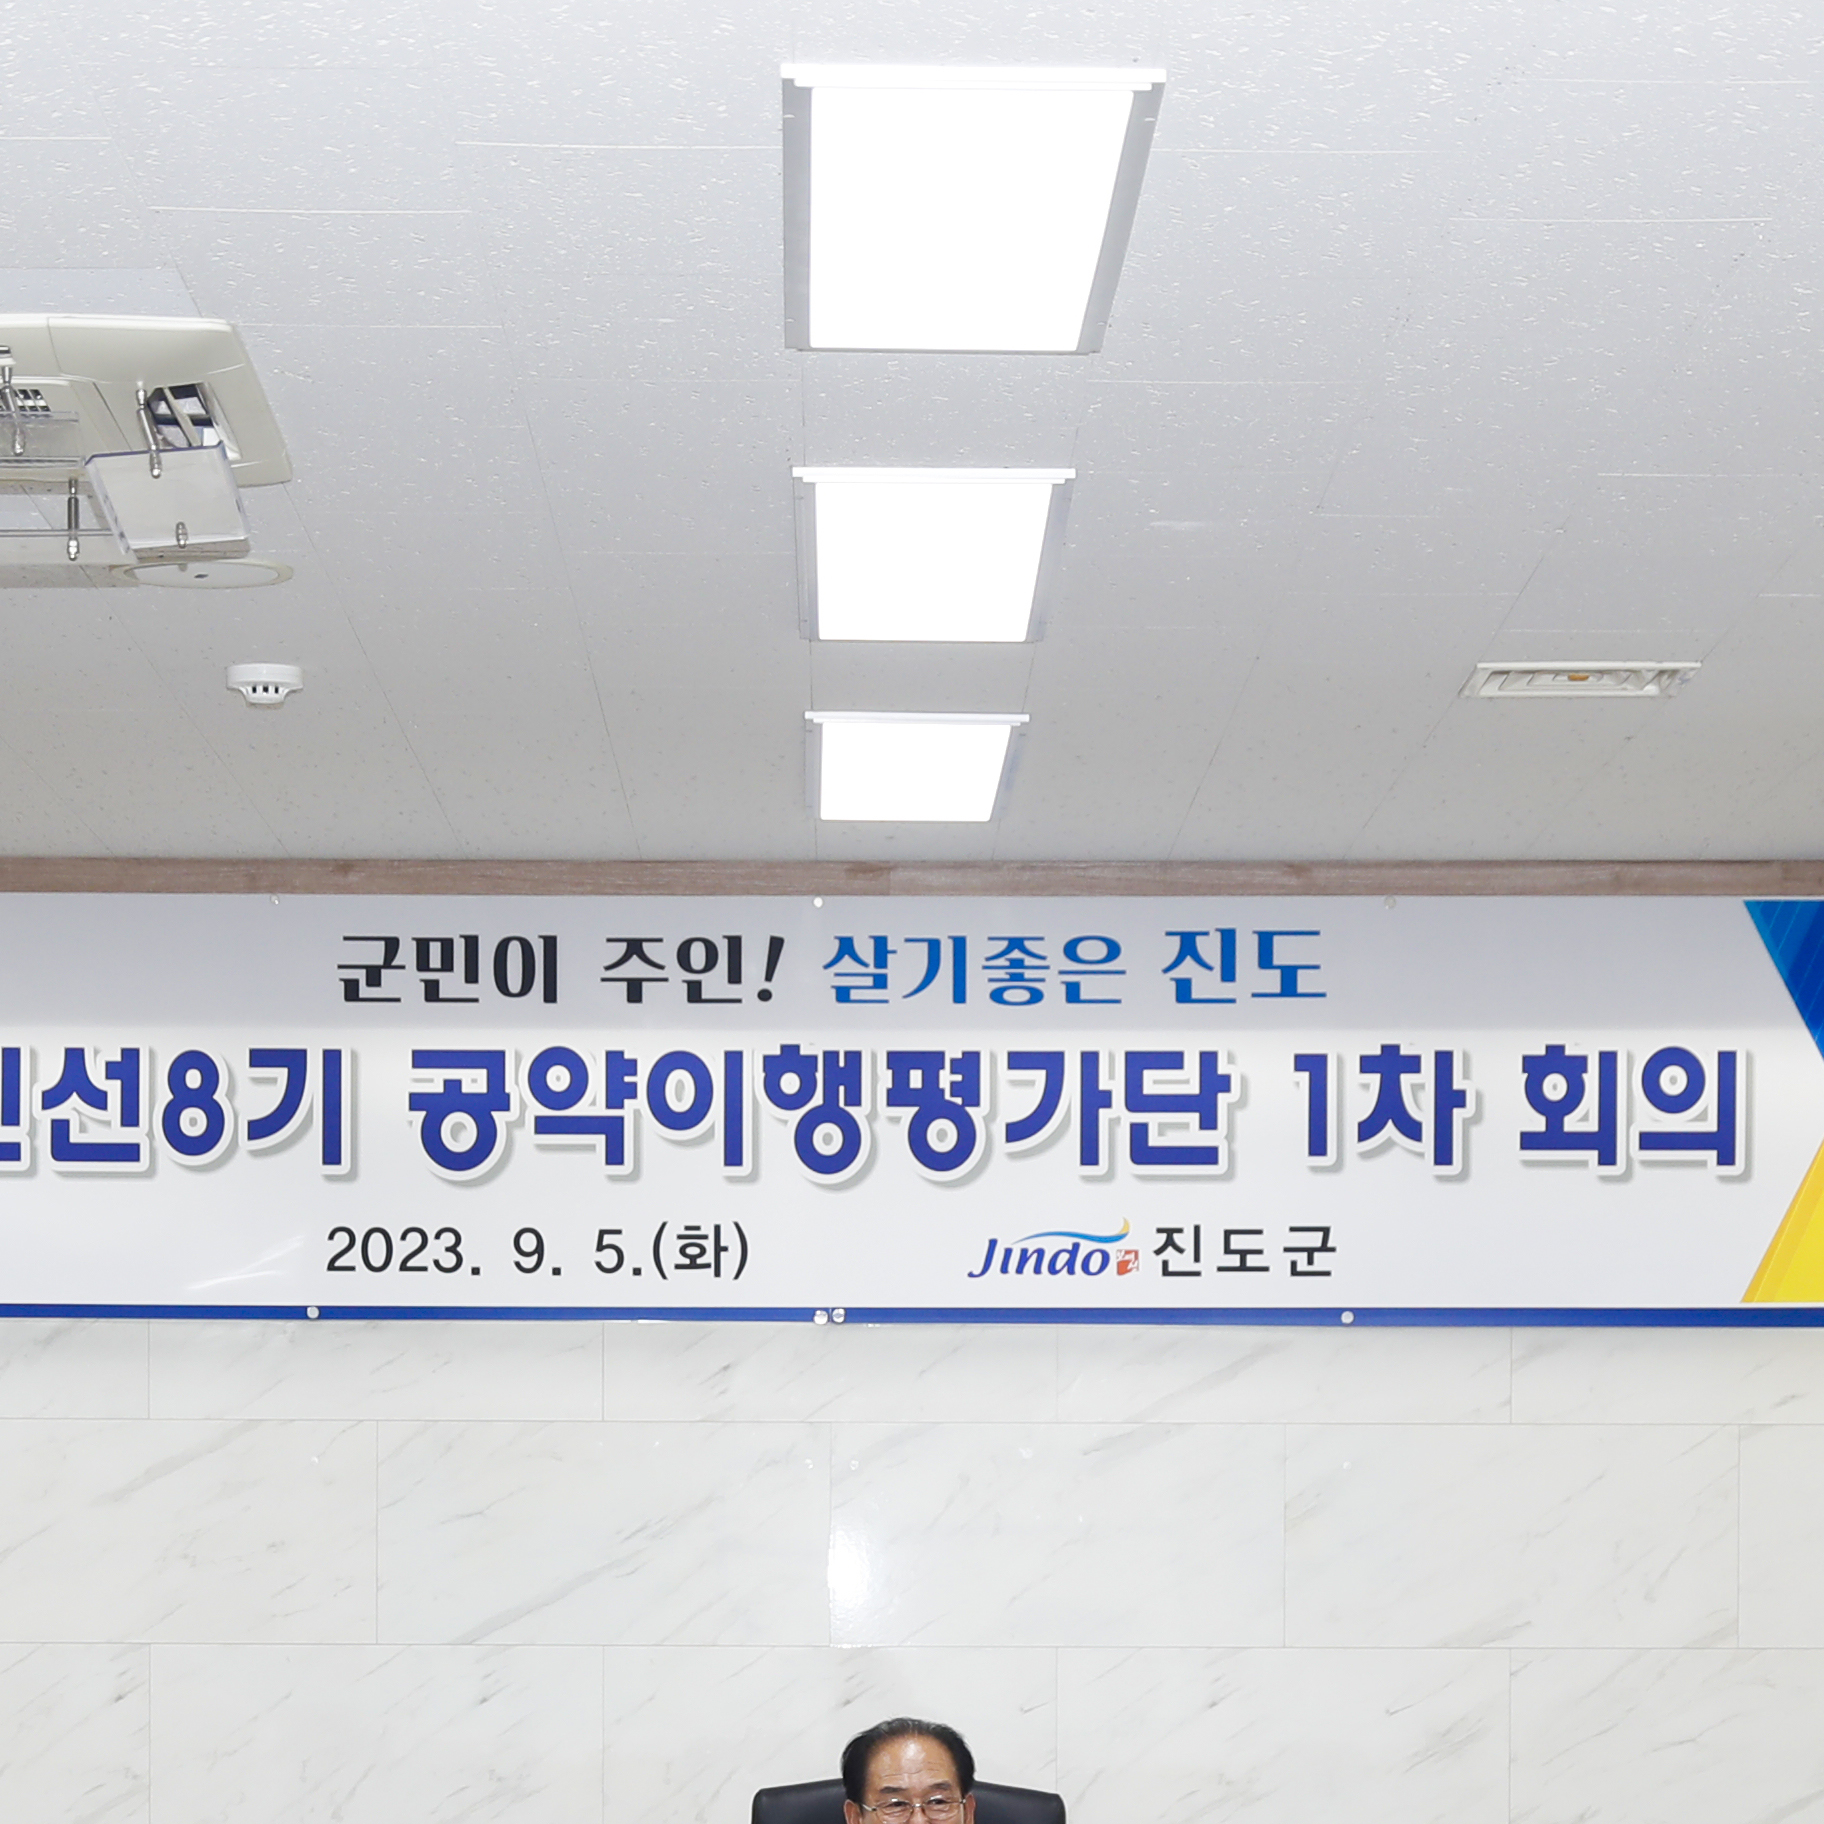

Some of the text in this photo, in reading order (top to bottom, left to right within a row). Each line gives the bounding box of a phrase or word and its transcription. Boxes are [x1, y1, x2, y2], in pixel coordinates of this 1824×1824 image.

[336, 926, 1328, 1007] 군민이 주인! 살기좋은 진도
[409, 1045, 1232, 1175] 공약이행평가단
[1294, 1046, 1466, 1165] 1차
[1521, 1047, 1738, 1166] 회의
[325, 1221, 749, 1280] 2023. 9. 5.(화)
[967, 1237, 1111, 1278] Jindo
[1152, 1223, 1338, 1279] 진도군
